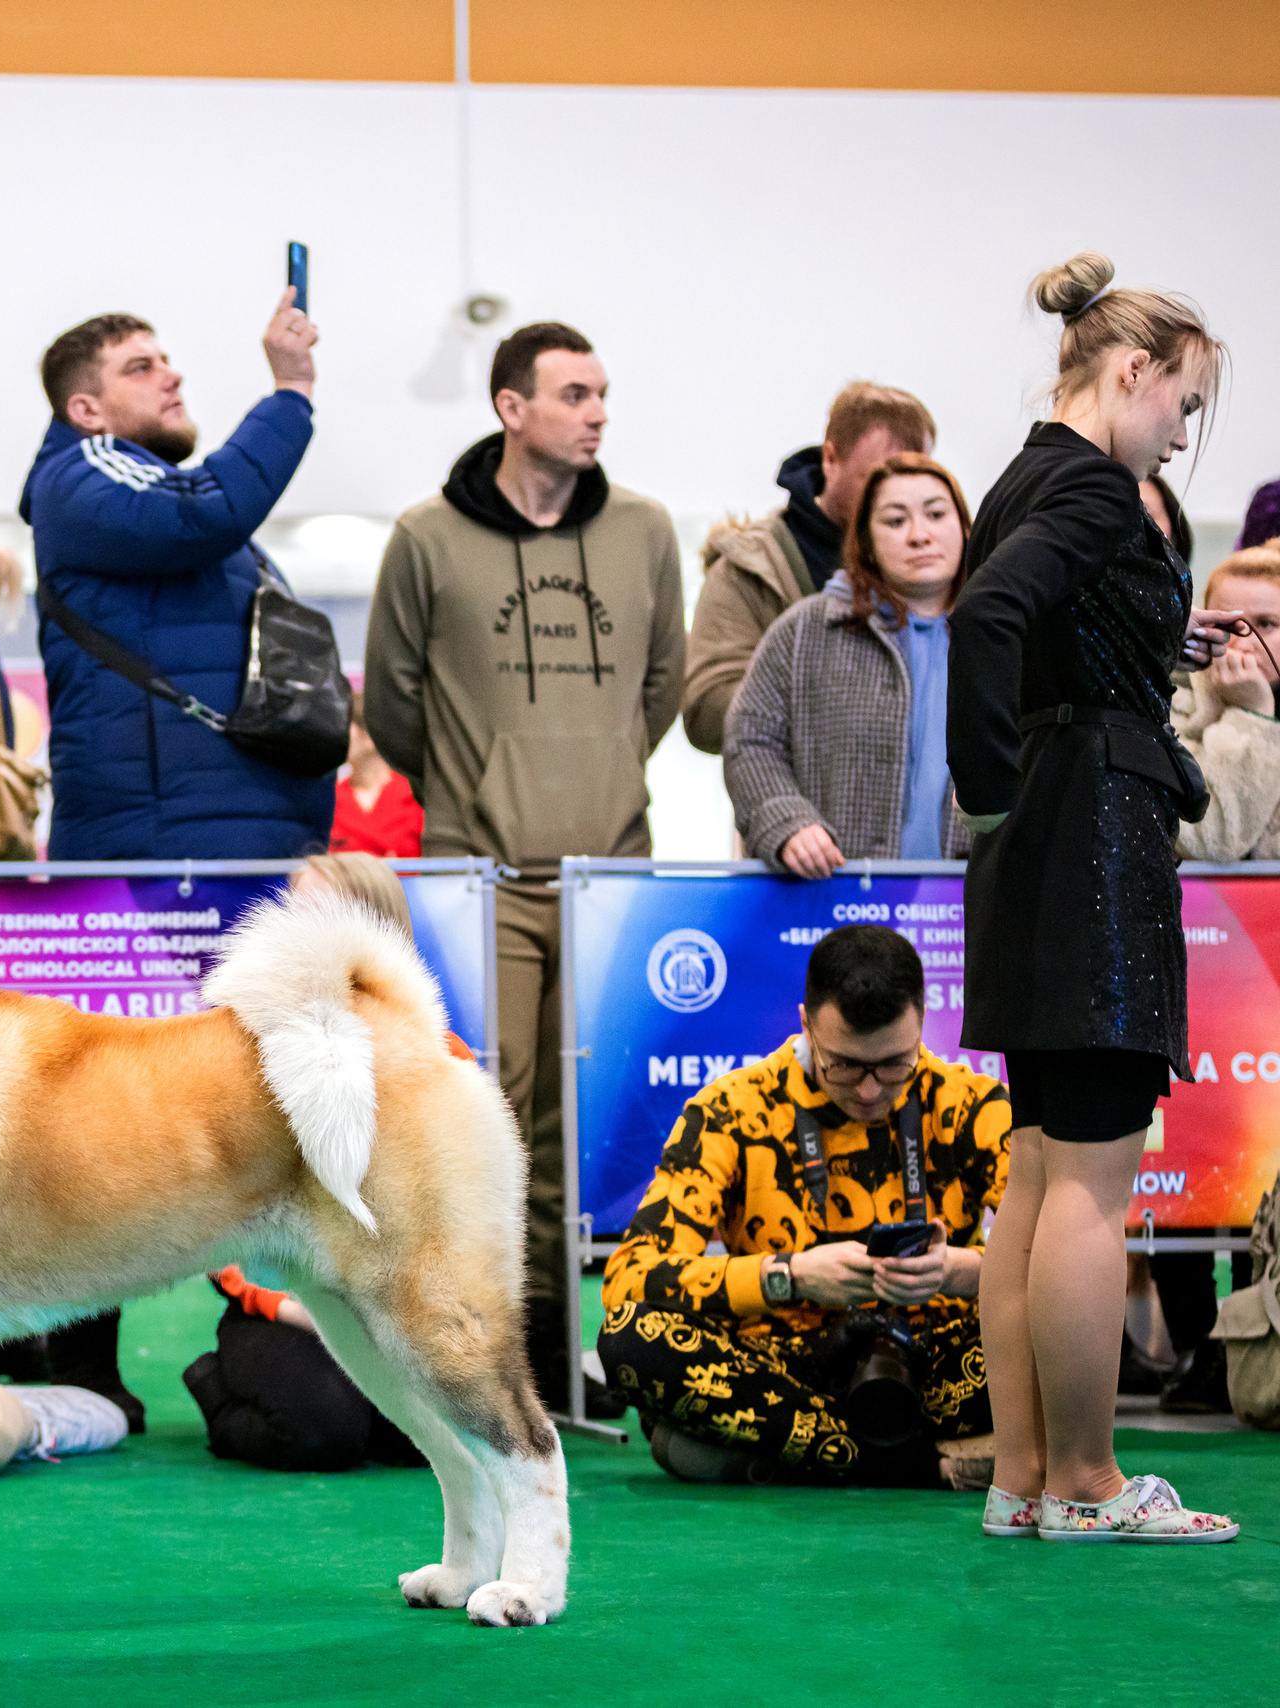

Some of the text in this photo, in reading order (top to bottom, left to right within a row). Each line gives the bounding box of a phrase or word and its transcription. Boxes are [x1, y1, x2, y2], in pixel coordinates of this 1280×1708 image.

[533, 624, 577, 638] PARIS
[83, 907, 220, 931] ОБЪЕДИНЕНИЙ
[832, 903, 891, 921] СОЮЗ
[10, 959, 137, 978] CINOLOGICAL
[141, 958, 201, 977] UNION
[648, 1054, 762, 1087] МЕЖ
[905, 1136, 921, 1194] SONY
